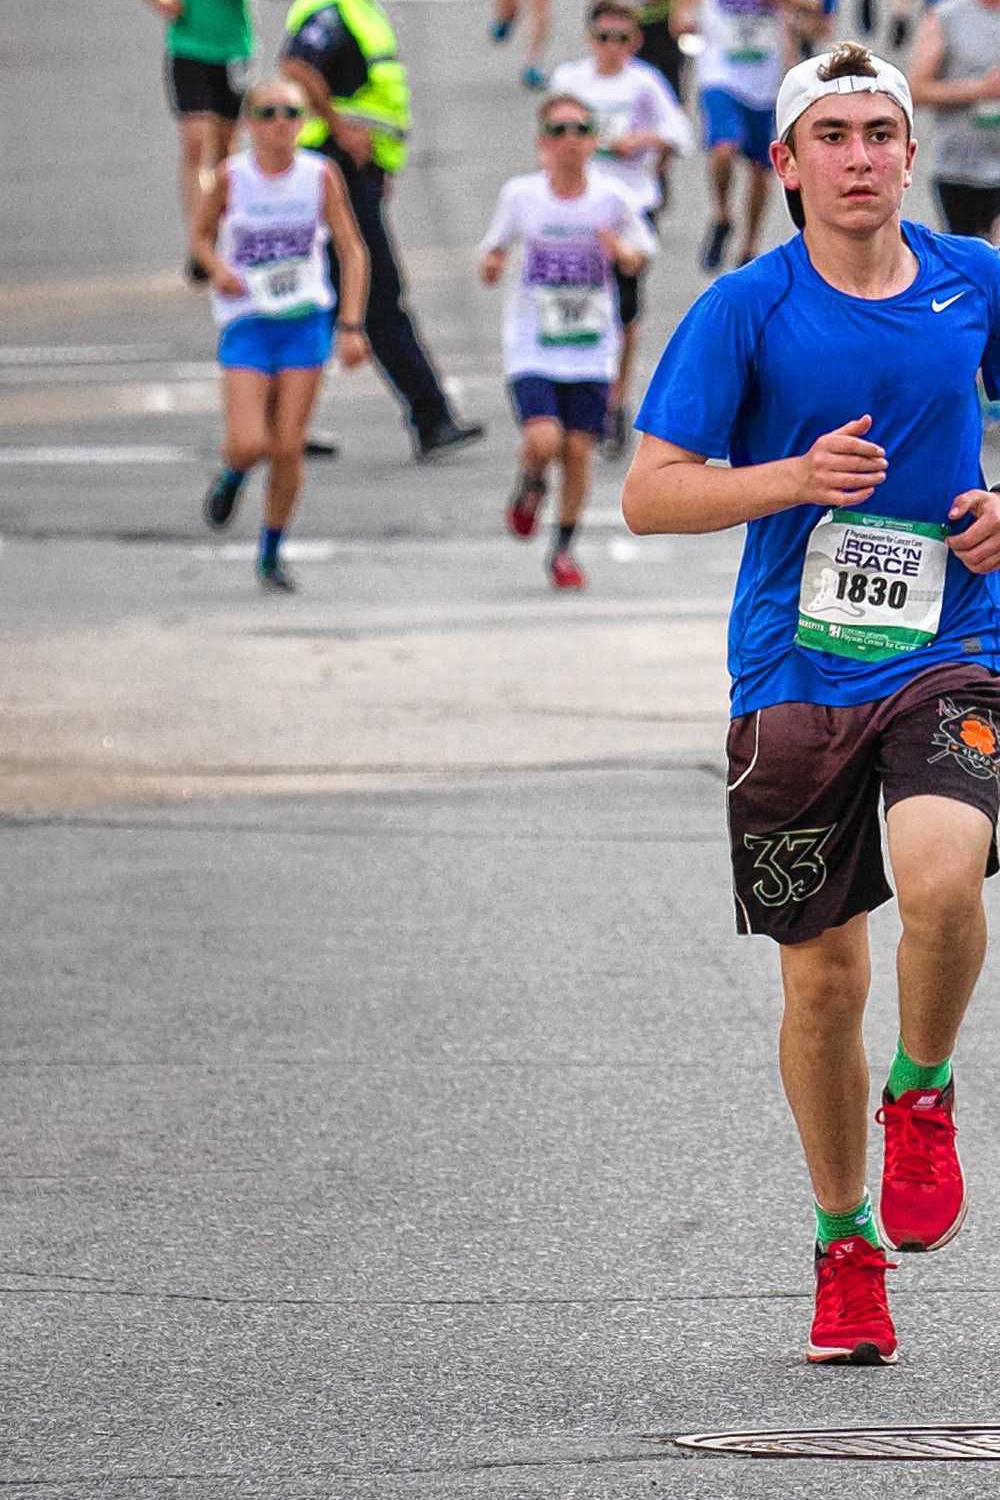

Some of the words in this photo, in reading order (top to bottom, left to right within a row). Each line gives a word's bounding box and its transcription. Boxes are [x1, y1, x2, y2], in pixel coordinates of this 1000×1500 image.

[893, 536, 912, 546] Cancer
[844, 551, 920, 577] RACE
[835, 571, 908, 609] 1830
[743, 823, 838, 908] 33
